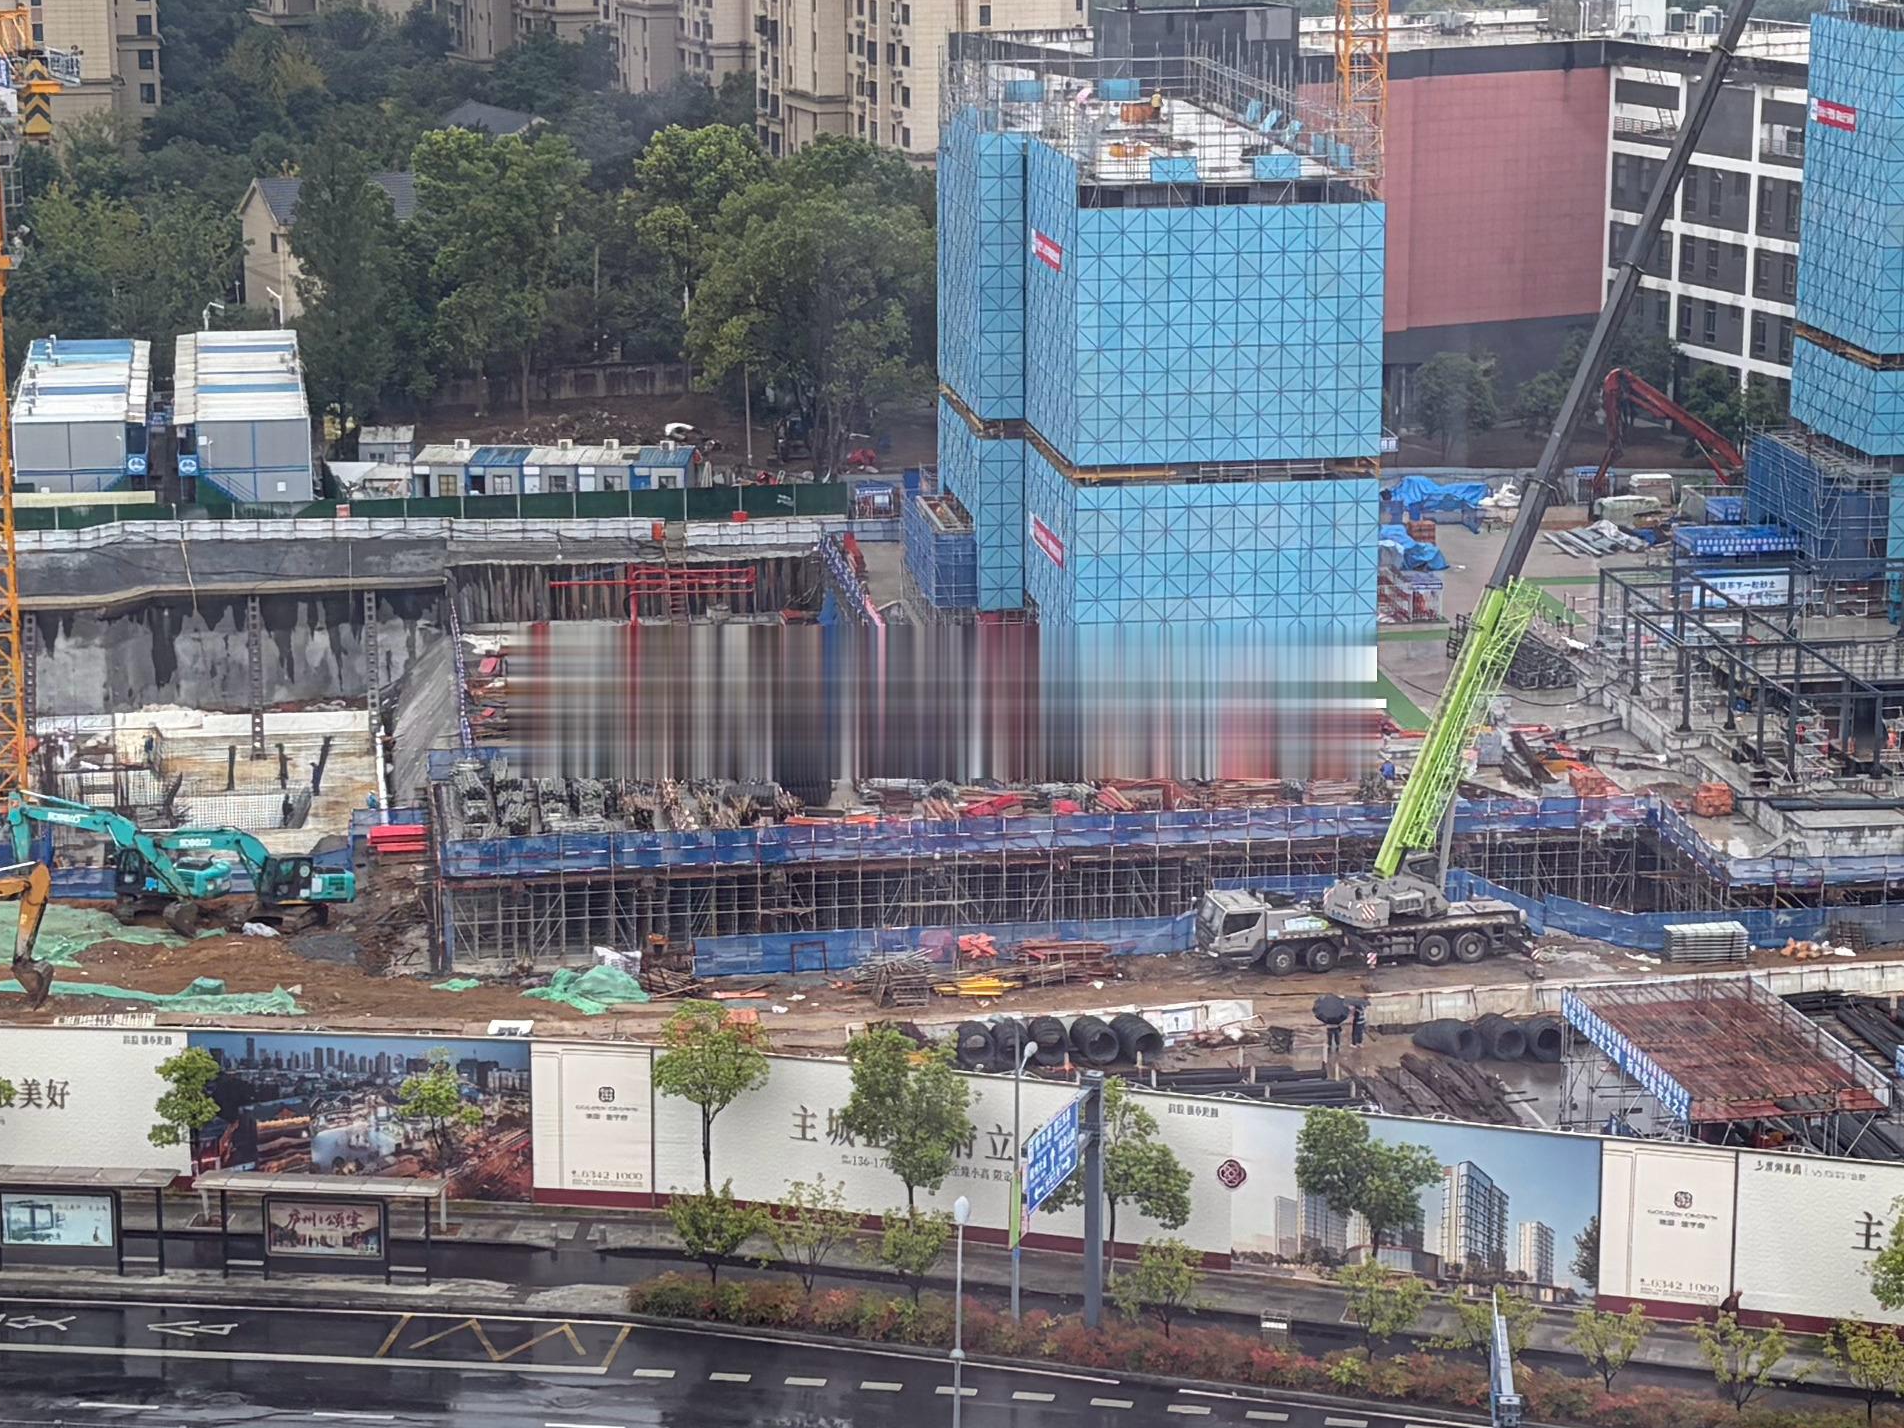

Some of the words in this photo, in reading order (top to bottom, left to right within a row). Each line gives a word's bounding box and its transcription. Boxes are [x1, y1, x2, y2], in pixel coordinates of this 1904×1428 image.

[581, 1170, 612, 1182] 6342
[614, 1171, 644, 1182] 1000
[1650, 1278, 1683, 1291] 6342
[1688, 1282, 1720, 1294] 1000
